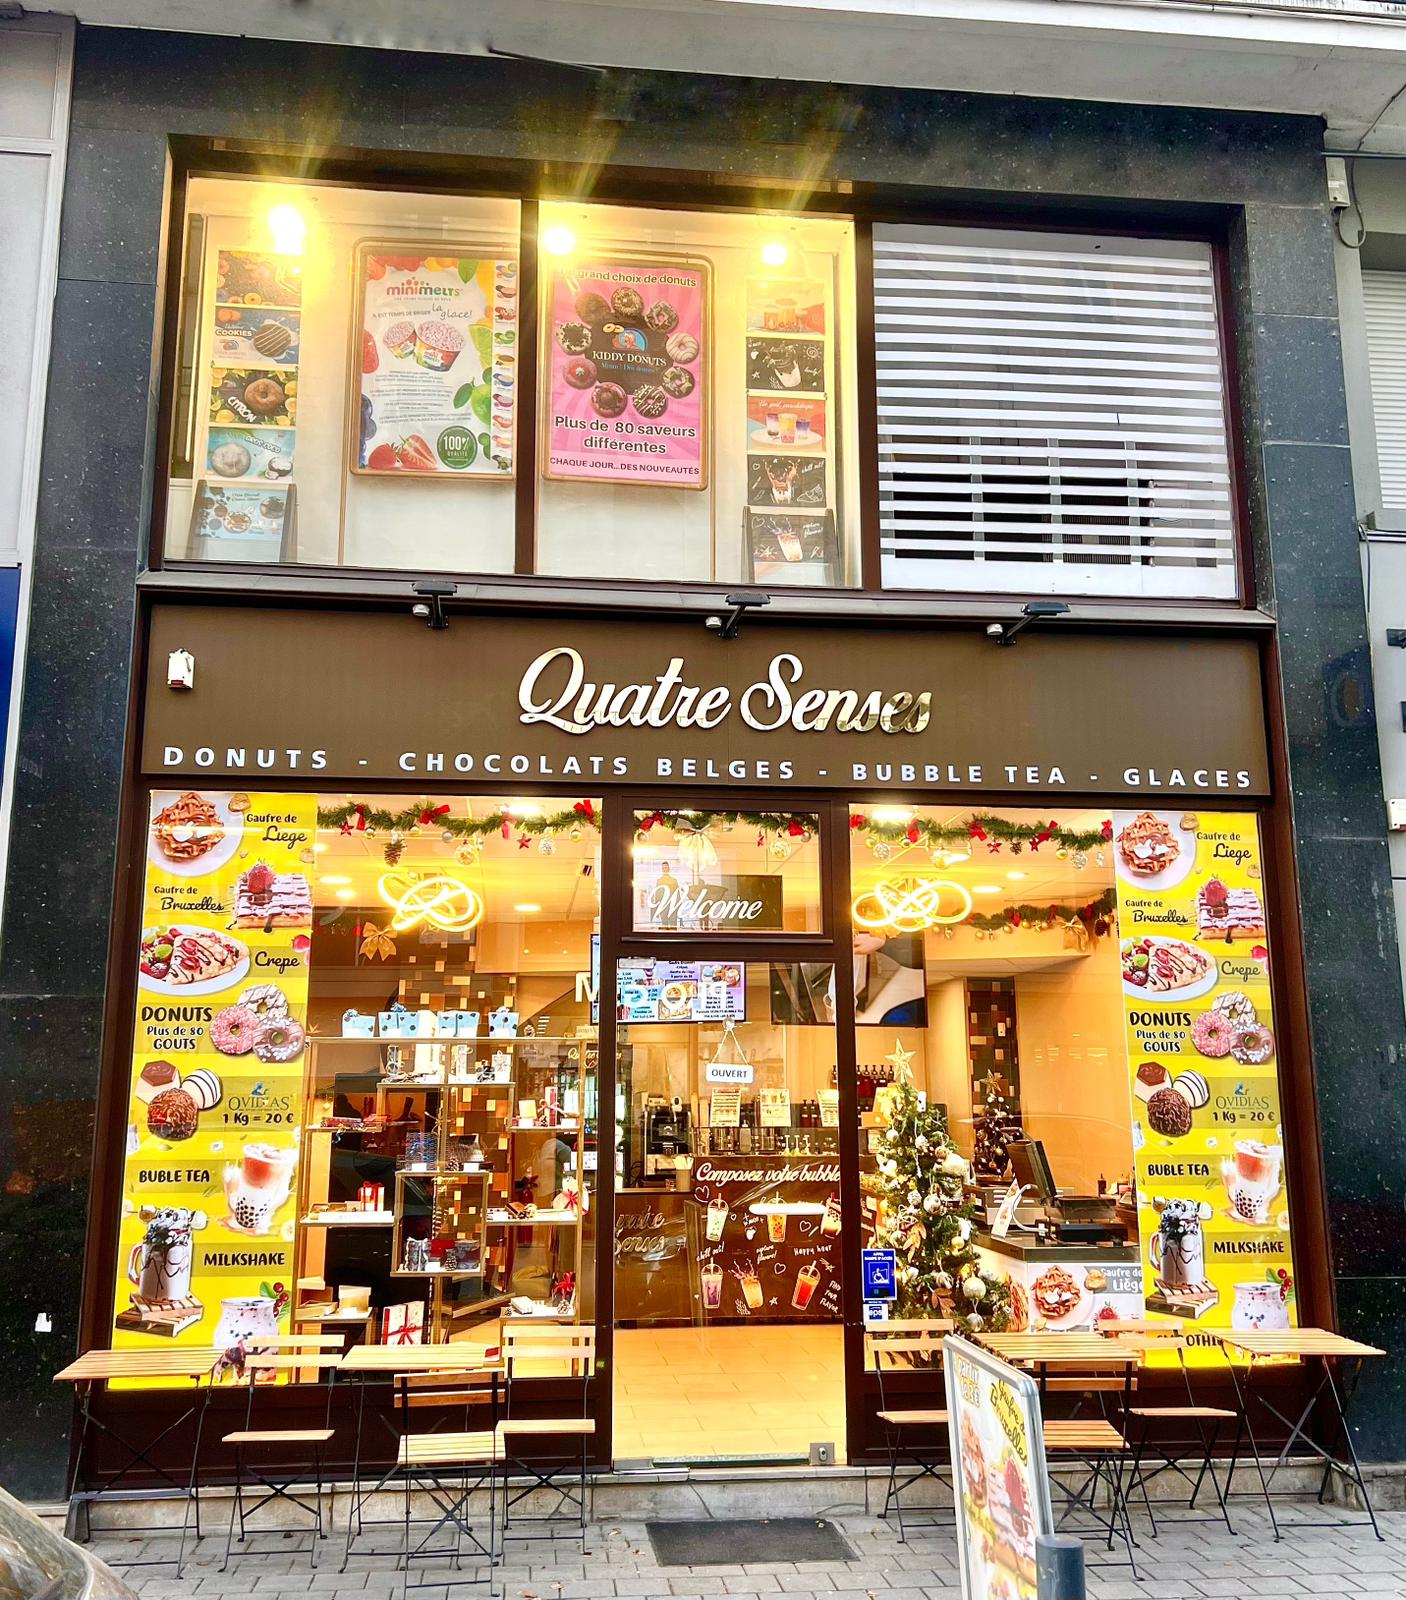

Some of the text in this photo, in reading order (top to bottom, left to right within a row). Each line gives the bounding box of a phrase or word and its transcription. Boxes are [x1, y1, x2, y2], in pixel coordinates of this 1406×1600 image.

[576, 271, 610, 280] grand
[612, 272, 642, 283] choix
[644, 274, 657, 284] de
[659, 273, 697, 287] donuts
[215, 329, 253, 337] COOKIES
[592, 350, 667, 366] KIDDY DONUTS
[227, 396, 257, 423] CITRON
[555, 416, 696, 437] Plus de 80 saveurs
[584, 436, 667, 454] différentes
[550, 457, 588, 467] CHAQUE
[639, 464, 700, 475] NOUVEAUTÉS
[518, 646, 933, 735] Quatre Senses
[163, 746, 328, 770] DONUTS
[399, 752, 629, 775] CHOCOLATS
[656, 758, 795, 779] BELGES
[852, 763, 983, 784] BUBBLE
[1005, 765, 1067, 784] TEA
[1123, 768, 1251, 789] GLACES
[246, 813, 298, 824] Gaufre de
[262, 825, 308, 850] Liege
[1196, 832, 1241, 841] Gaufre de
[1213, 843, 1252, 866] Liege
[154, 885, 198, 895] Gaufre de
[160, 896, 225, 912] Bruxelles
[648, 884, 763, 920] Welcome
[1125, 899, 1164, 908] Gaufre de
[1132, 910, 1189, 924] Bruxelles
[254, 951, 300, 974] Crepe
[1221, 961, 1261, 983] Crepe
[141, 1006, 213, 1023] DONUTS
[1129, 1011, 1191, 1027] DONUTS
[147, 1025, 204, 1036] Plus de 80
[1136, 1029, 1186, 1039] Plus de 80
[153, 1038, 196, 1050] GOUTS
[1143, 1041, 1181, 1053] GOUTS
[711, 1069, 748, 1079] OUVERT
[228, 1096, 290, 1111] OVIDAS
[1215, 1095, 1269, 1110] OVIDIAS
[223, 1113, 229, 1124] 1
[234, 1112, 249, 1126] Kg
[265, 1112, 282, 1123] 20
[286, 1112, 294, 1123] €
[1212, 1111, 1219, 1121] 1
[1223, 1111, 1236, 1124] Kg
[1249, 1112, 1265, 1121] 20
[1268, 1112, 1275, 1121] €
[139, 1170, 210, 1183] BUBLE TEA
[696, 1162, 840, 1187] Composez votre bubble
[1147, 1164, 1210, 1176] BUBLE TEA
[1214, 1241, 1285, 1254] MILKSHAKE
[204, 1252, 285, 1266] MILKSHAKE
[1101, 1268, 1131, 1278] Gaufre
